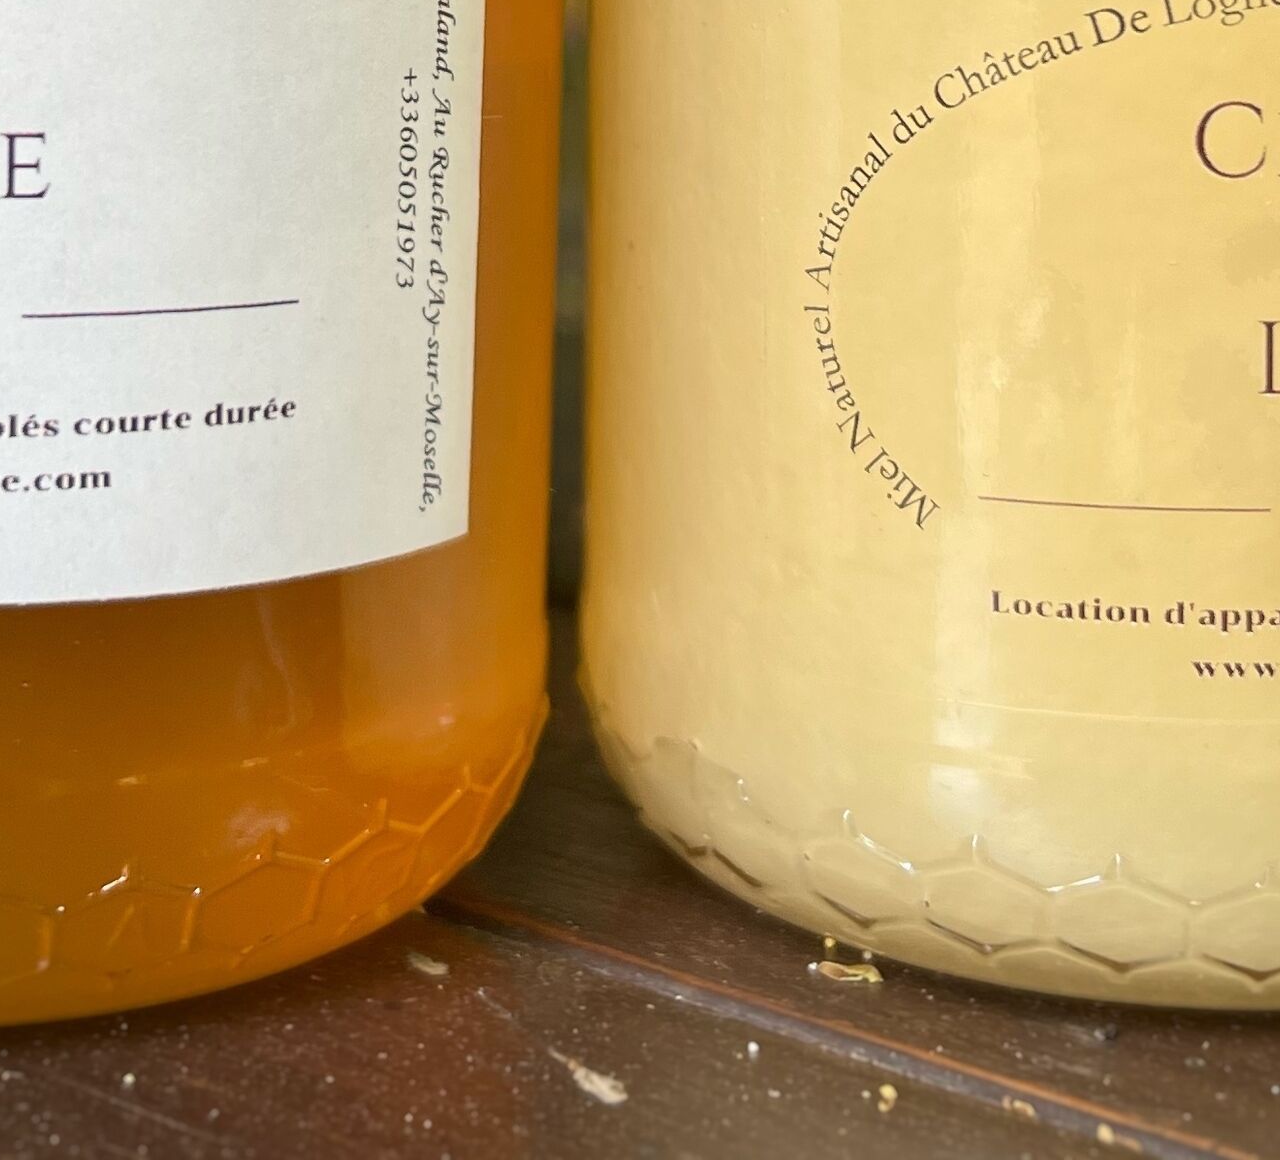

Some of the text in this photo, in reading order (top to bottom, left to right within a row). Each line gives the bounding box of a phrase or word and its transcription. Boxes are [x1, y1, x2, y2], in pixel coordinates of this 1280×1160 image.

[1084, 7, 1152, 48] De
[934, 30, 1083, 109] Château
[432, 87, 452, 139] Au
[891, 104, 935, 144] du
[395, 66, 420, 289] +33605051973
[429, 146, 450, 250] Rucher
[804, 132, 893, 290] Artisanal
[73, 407, 192, 434] courte
[204, 397, 298, 427] durée
[419, 258, 449, 513] d'Ay-sur-Moselle,
[803, 304, 875, 454] Naturel
[865, 446, 941, 530] Miel
[991, 590, 1151, 624] Location
